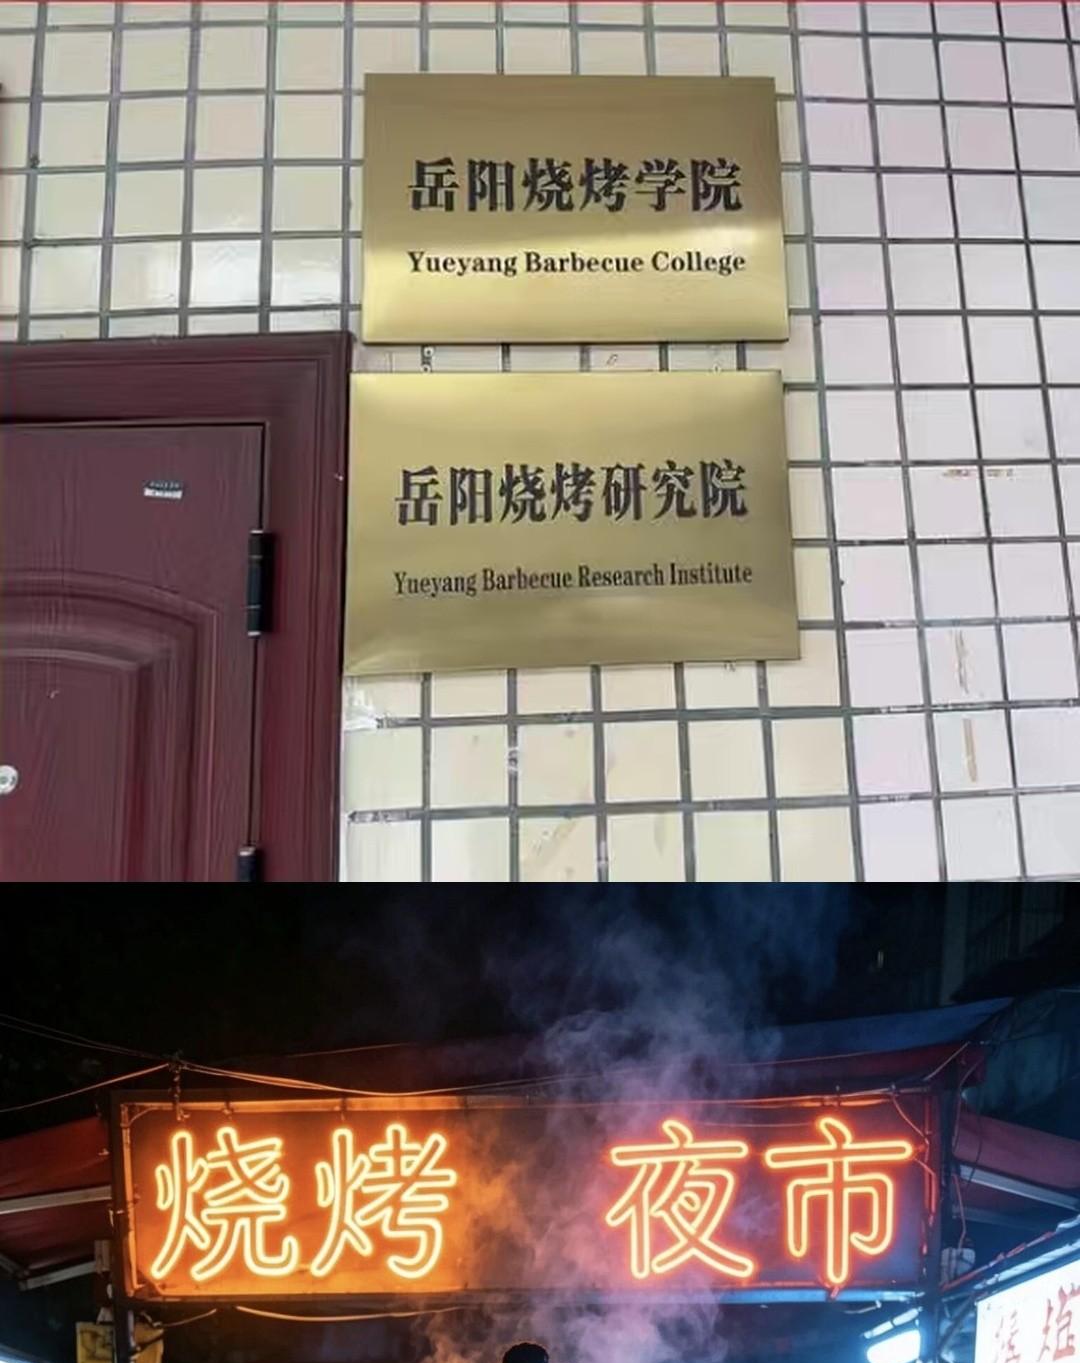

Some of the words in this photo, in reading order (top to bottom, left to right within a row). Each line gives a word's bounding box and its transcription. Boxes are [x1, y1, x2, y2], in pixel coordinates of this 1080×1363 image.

[407, 156, 744, 213] 岳阳烧烤学院
[406, 249, 518, 277] Yueyang
[524, 250, 644, 273] Barbecue
[651, 249, 747, 276] College
[394, 458, 749, 526] 岳阳烧烤研究院
[394, 571, 477, 598] Yueyang
[482, 567, 573, 592] Barbecue
[578, 563, 664, 588] Research
[670, 562, 753, 585] Institute
[150, 1123, 458, 1281] 烧烤
[604, 1117, 915, 1285] 夜市
